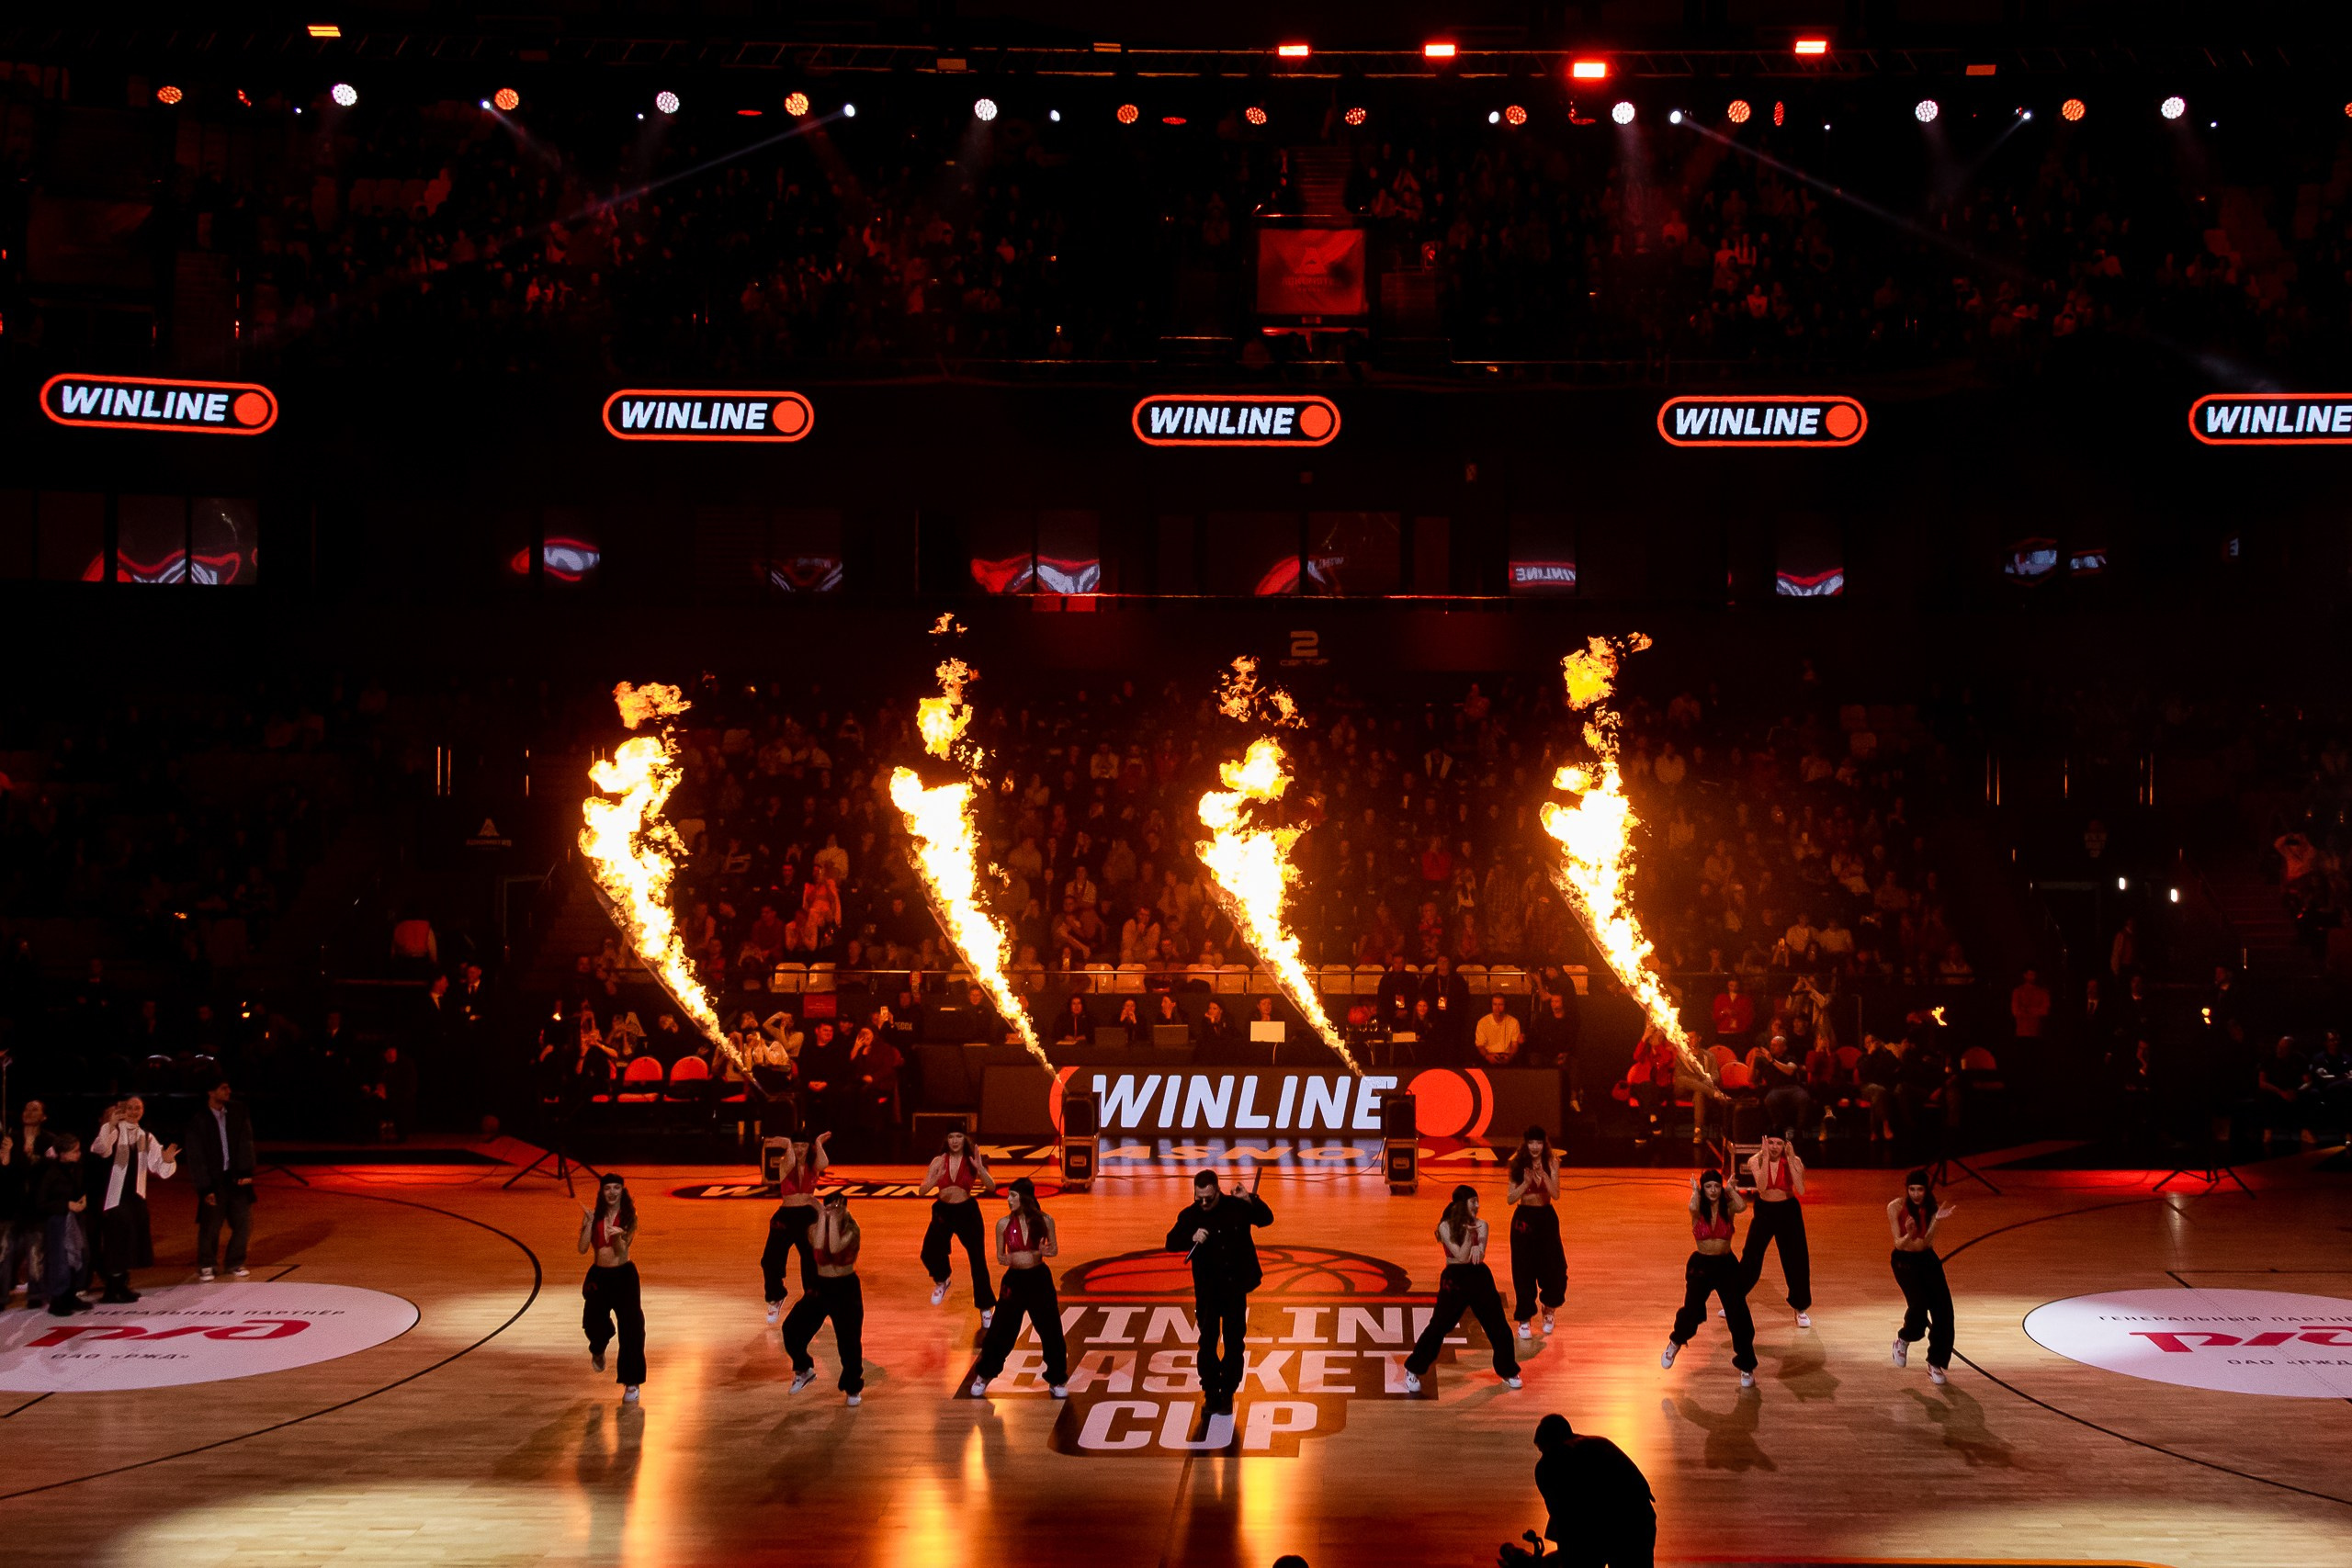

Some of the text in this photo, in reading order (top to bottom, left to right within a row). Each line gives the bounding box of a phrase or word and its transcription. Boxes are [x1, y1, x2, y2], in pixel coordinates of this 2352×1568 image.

[62, 385, 229, 422] WINLINE
[623, 400, 767, 430] WINLINE
[1150, 406, 1295, 434] WINLINE
[1676, 407, 1821, 435] WINLINE
[2207, 405, 2352, 434] WINLINE
[1290, 630, 1318, 657] 2
[1092, 1074, 1398, 1129] WINLINE
[974, 1145, 1568, 1160] KASNOA
[985, 1349, 1415, 1393] BASKET
[1077, 1400, 1319, 1450] CUP
